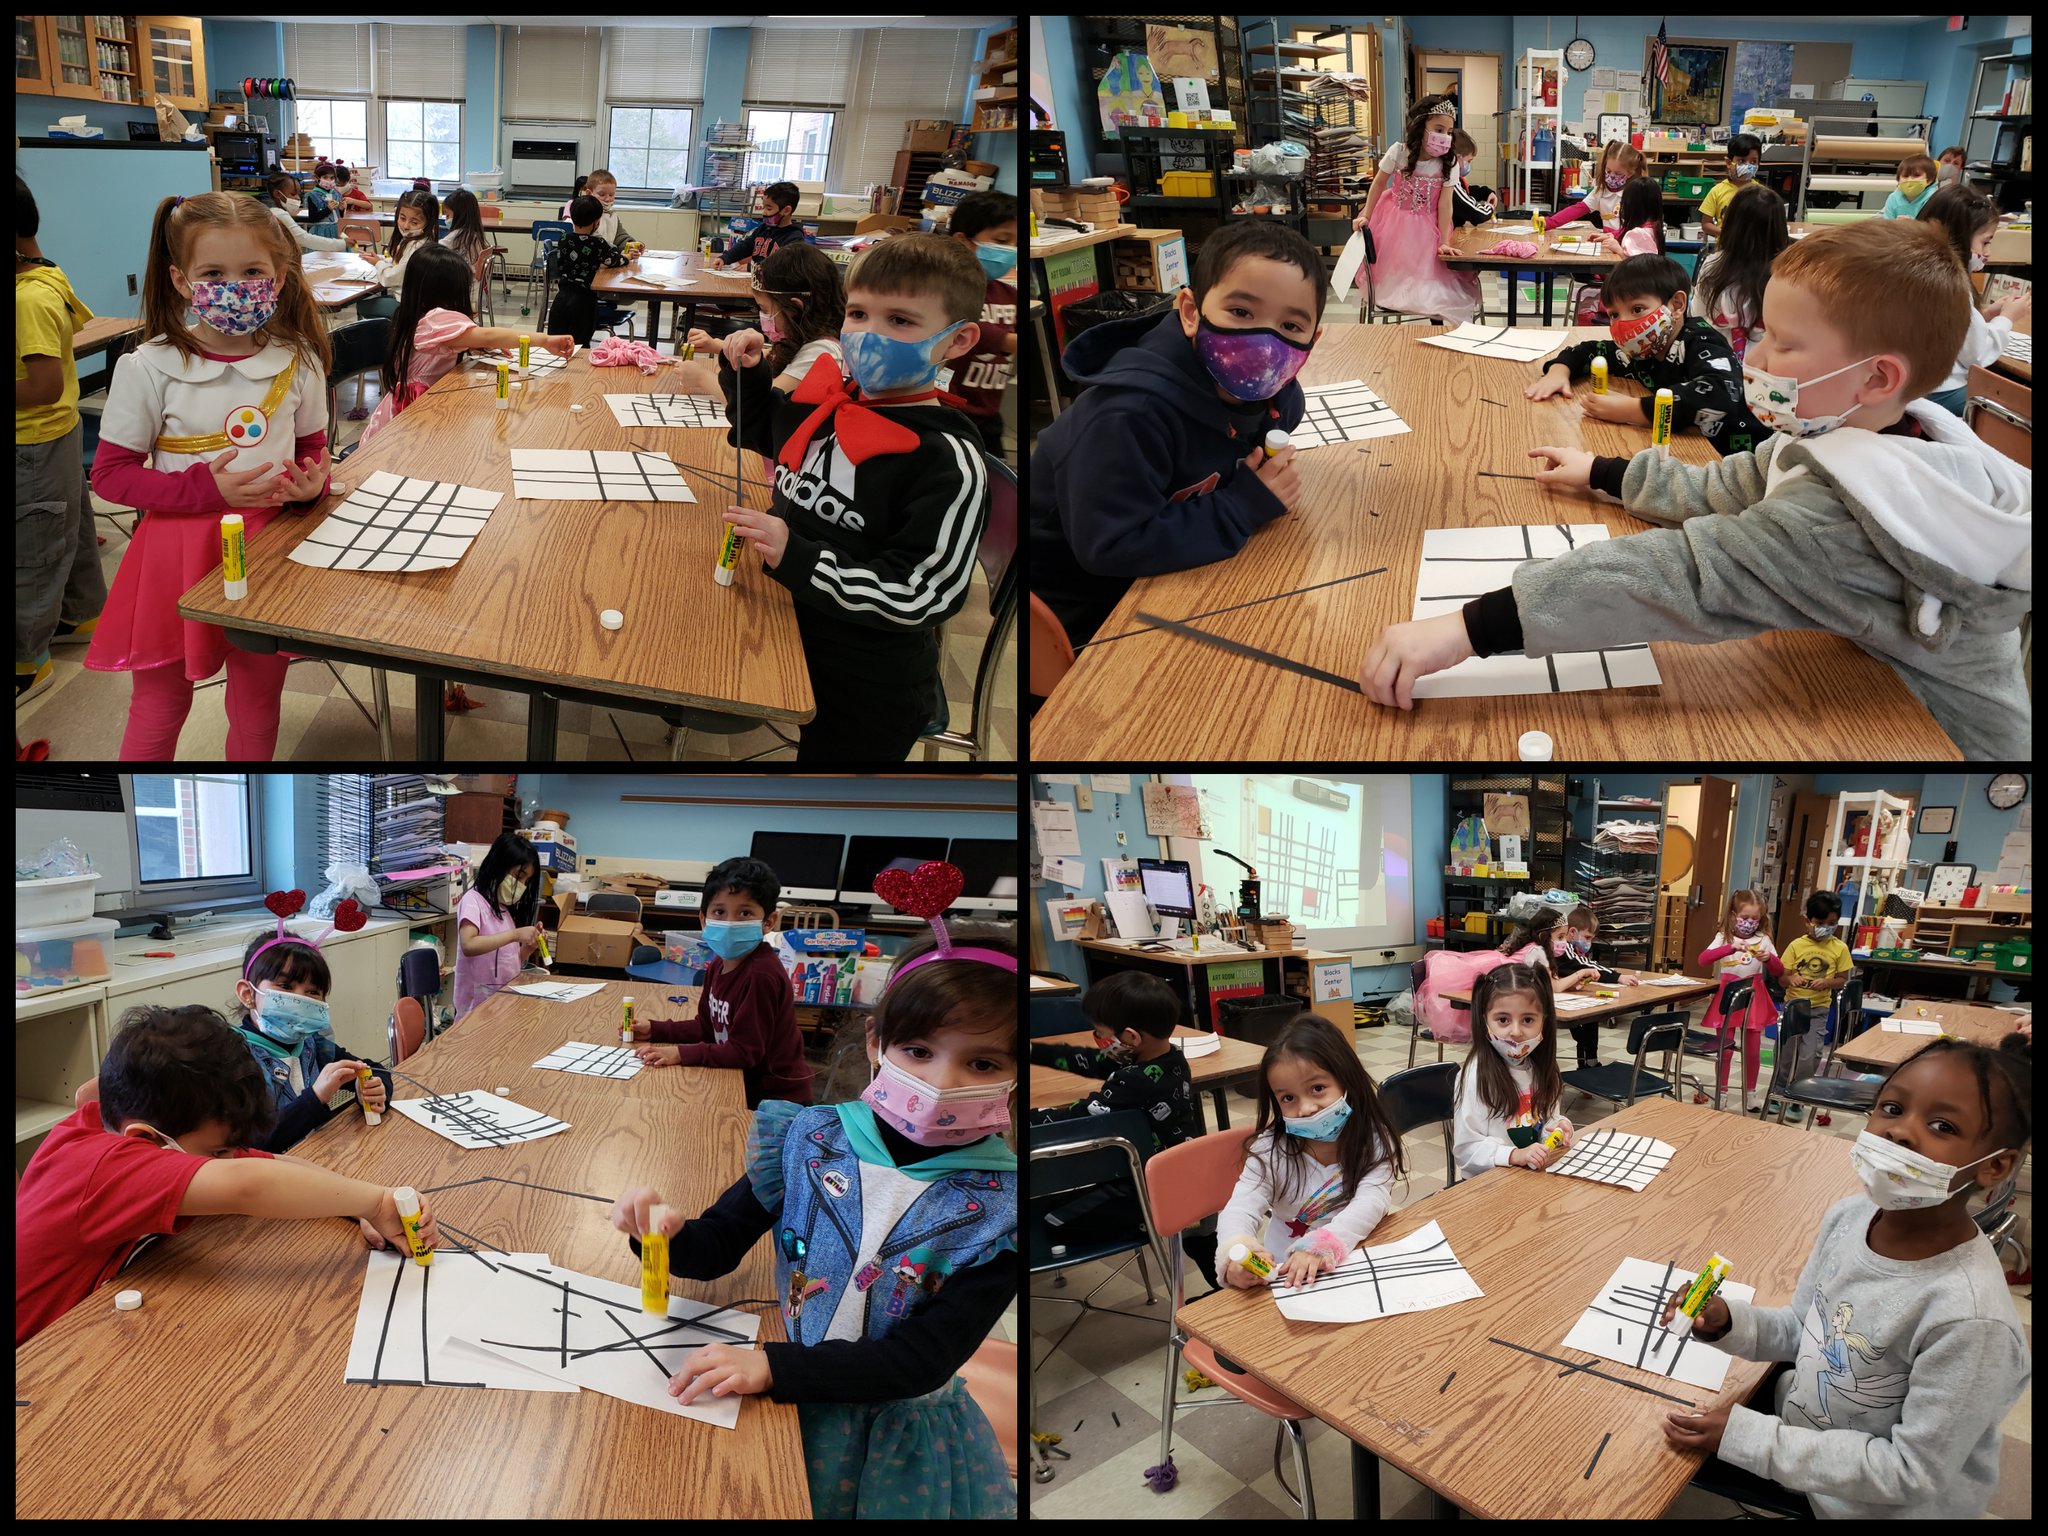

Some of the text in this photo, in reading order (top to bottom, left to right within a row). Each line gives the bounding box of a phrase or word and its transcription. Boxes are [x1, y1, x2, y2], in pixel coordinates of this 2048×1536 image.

[931, 186, 967, 199] BLIZZA
[1164, 249, 1177, 260] Blocks
[1050, 255, 1091, 280] ART ROOM rules
[1165, 260, 1179, 272] Center
[1664, 404, 1672, 424] UHU
[775, 464, 866, 533] adidas
[731, 535, 743, 550] HU
[1212, 967, 1258, 982] ART ROOM rules
[1323, 969, 1341, 977] Blocks
[1323, 977, 1343, 985] Center
[415, 1246, 432, 1258] UHU
